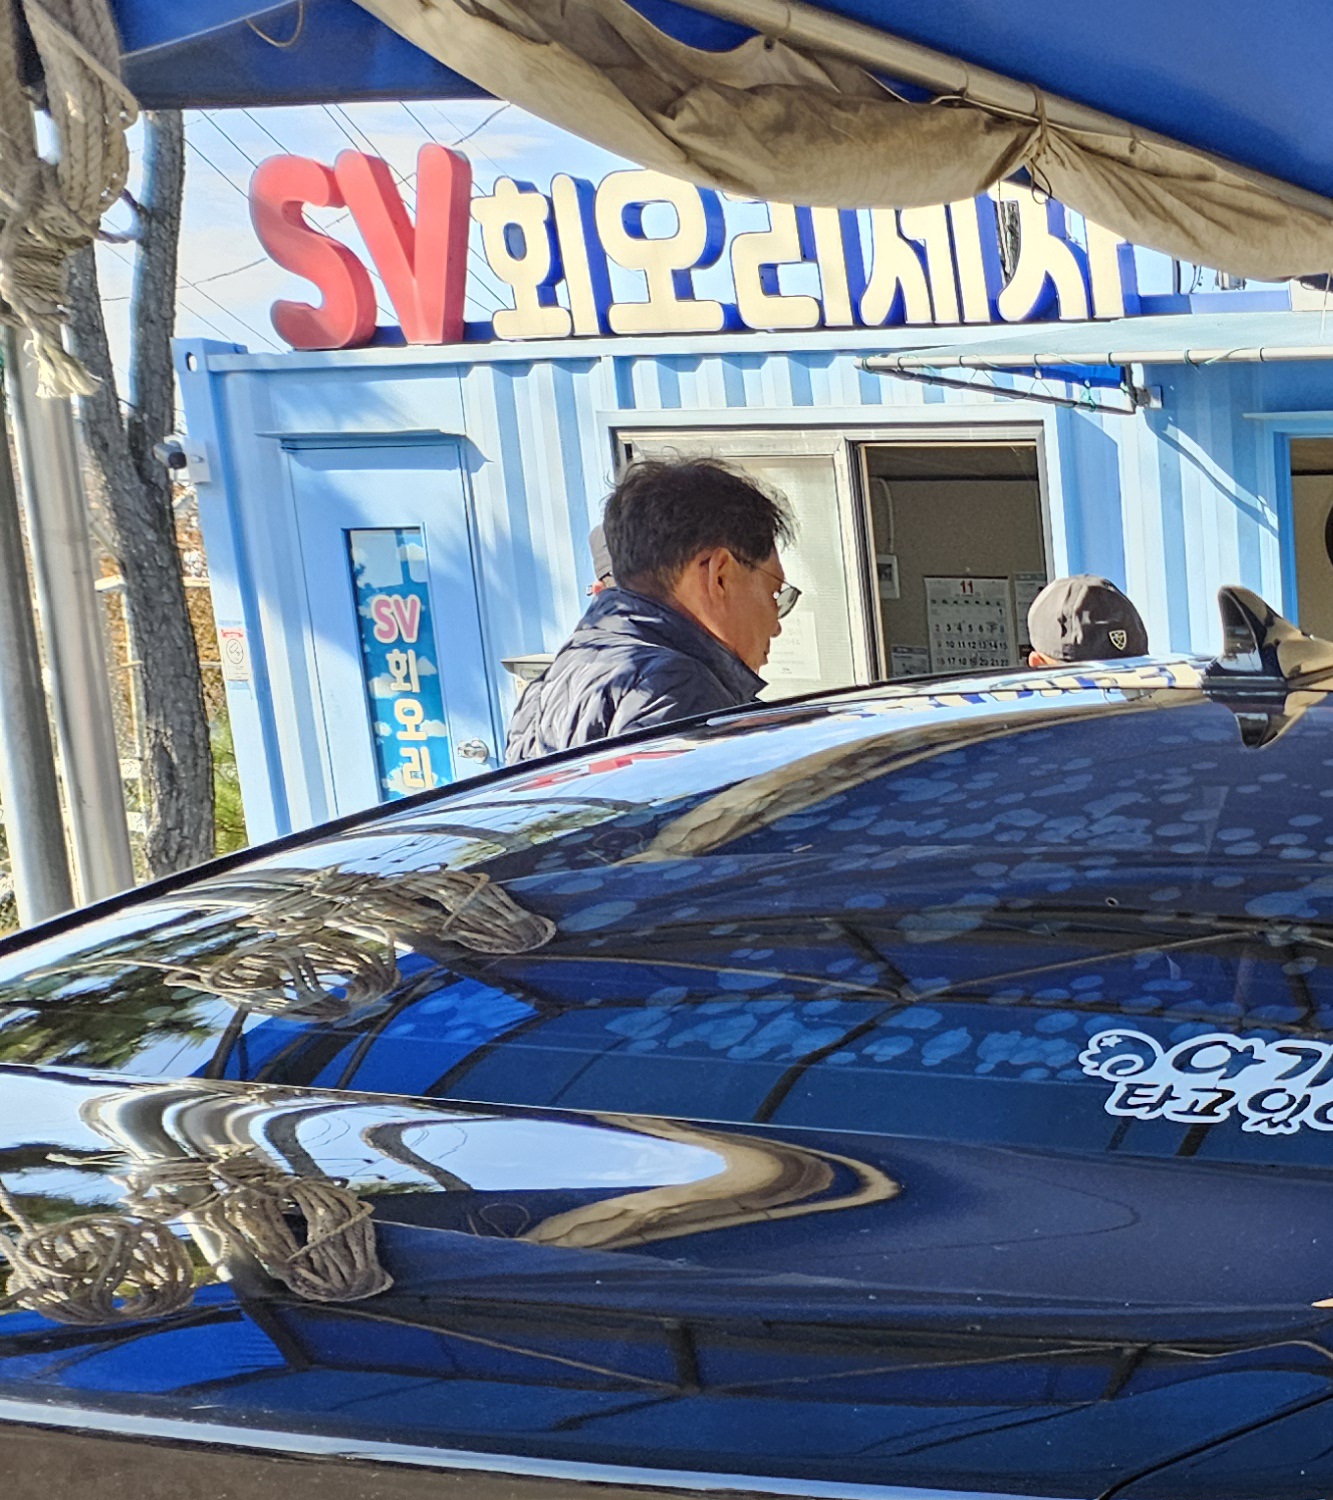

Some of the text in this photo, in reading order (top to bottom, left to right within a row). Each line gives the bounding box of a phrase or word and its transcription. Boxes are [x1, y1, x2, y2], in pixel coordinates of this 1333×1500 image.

[249, 142, 473, 349] SV
[960, 580, 974, 594] 11
[370, 593, 421, 644] SV
